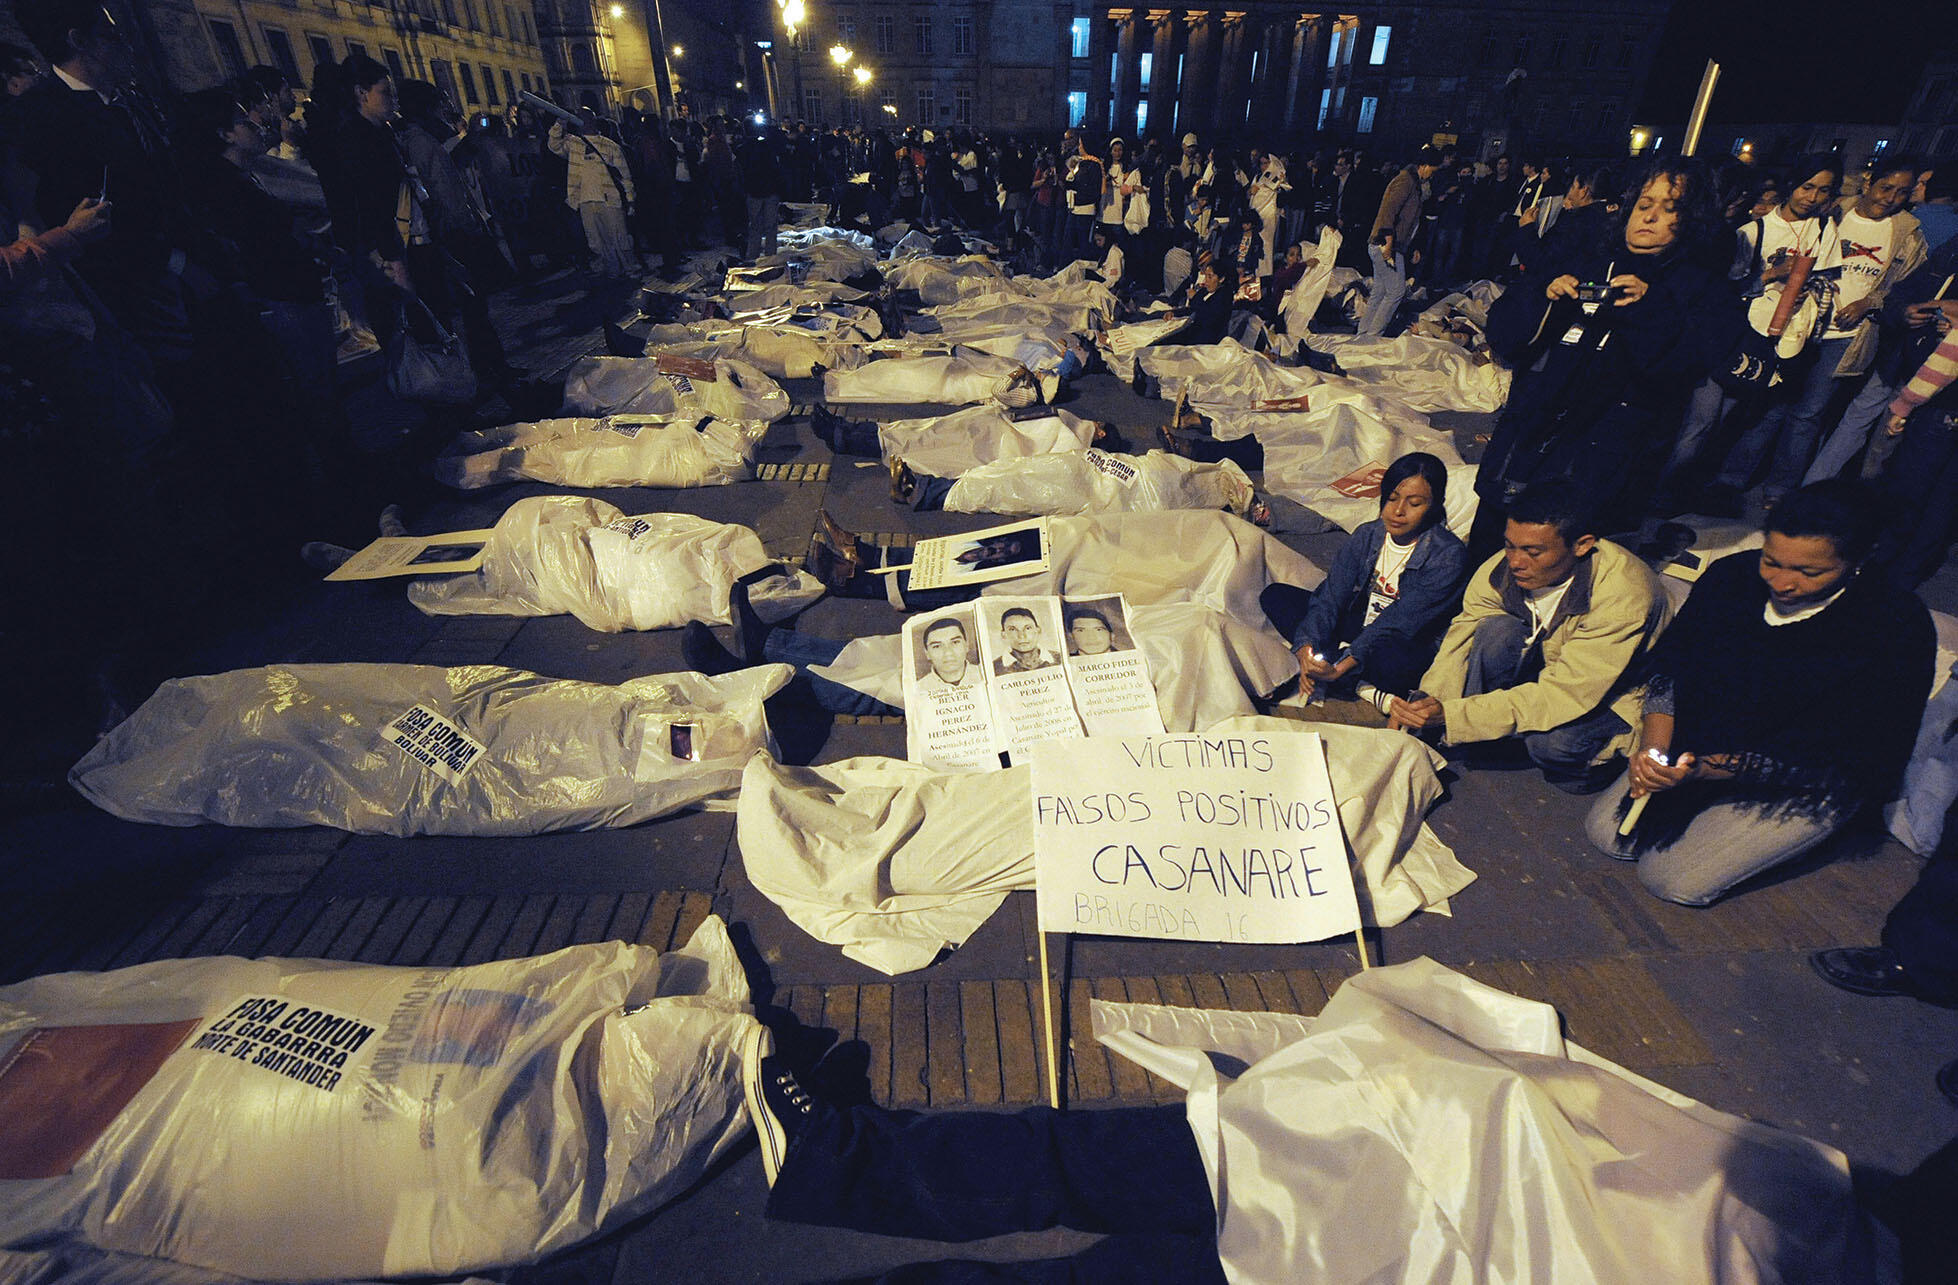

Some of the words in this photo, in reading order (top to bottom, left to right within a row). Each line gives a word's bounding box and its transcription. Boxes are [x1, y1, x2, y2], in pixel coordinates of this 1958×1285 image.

[1000, 679, 1036, 690] CARLOS
[1037, 673, 1063, 685] JULIO
[1079, 663, 1110, 672] MARCO
[1112, 659, 1140, 668] FIDEL
[1085, 670, 1136, 683] CORREDOR
[402, 707, 434, 730] FOSA
[935, 703, 975, 716] IGNACIO
[394, 735, 437, 768] BOLIVAR
[418, 735, 433, 749] DE
[428, 742, 466, 775] BOLIVAR
[1038, 792, 1151, 825] FALSOS
[1093, 845, 1328, 899] CASANARE
[1075, 892, 1201, 935] BRIGADA
[226, 998, 289, 1025] FOSA
[279, 1007, 376, 1053] COMÚN
[209, 1018, 236, 1033] LA
[235, 1021, 348, 1069] GABARRRA
[190, 1032, 239, 1053] NORTE
[231, 1040, 258, 1061] DE
[251, 1046, 342, 1093] SANTANDER
